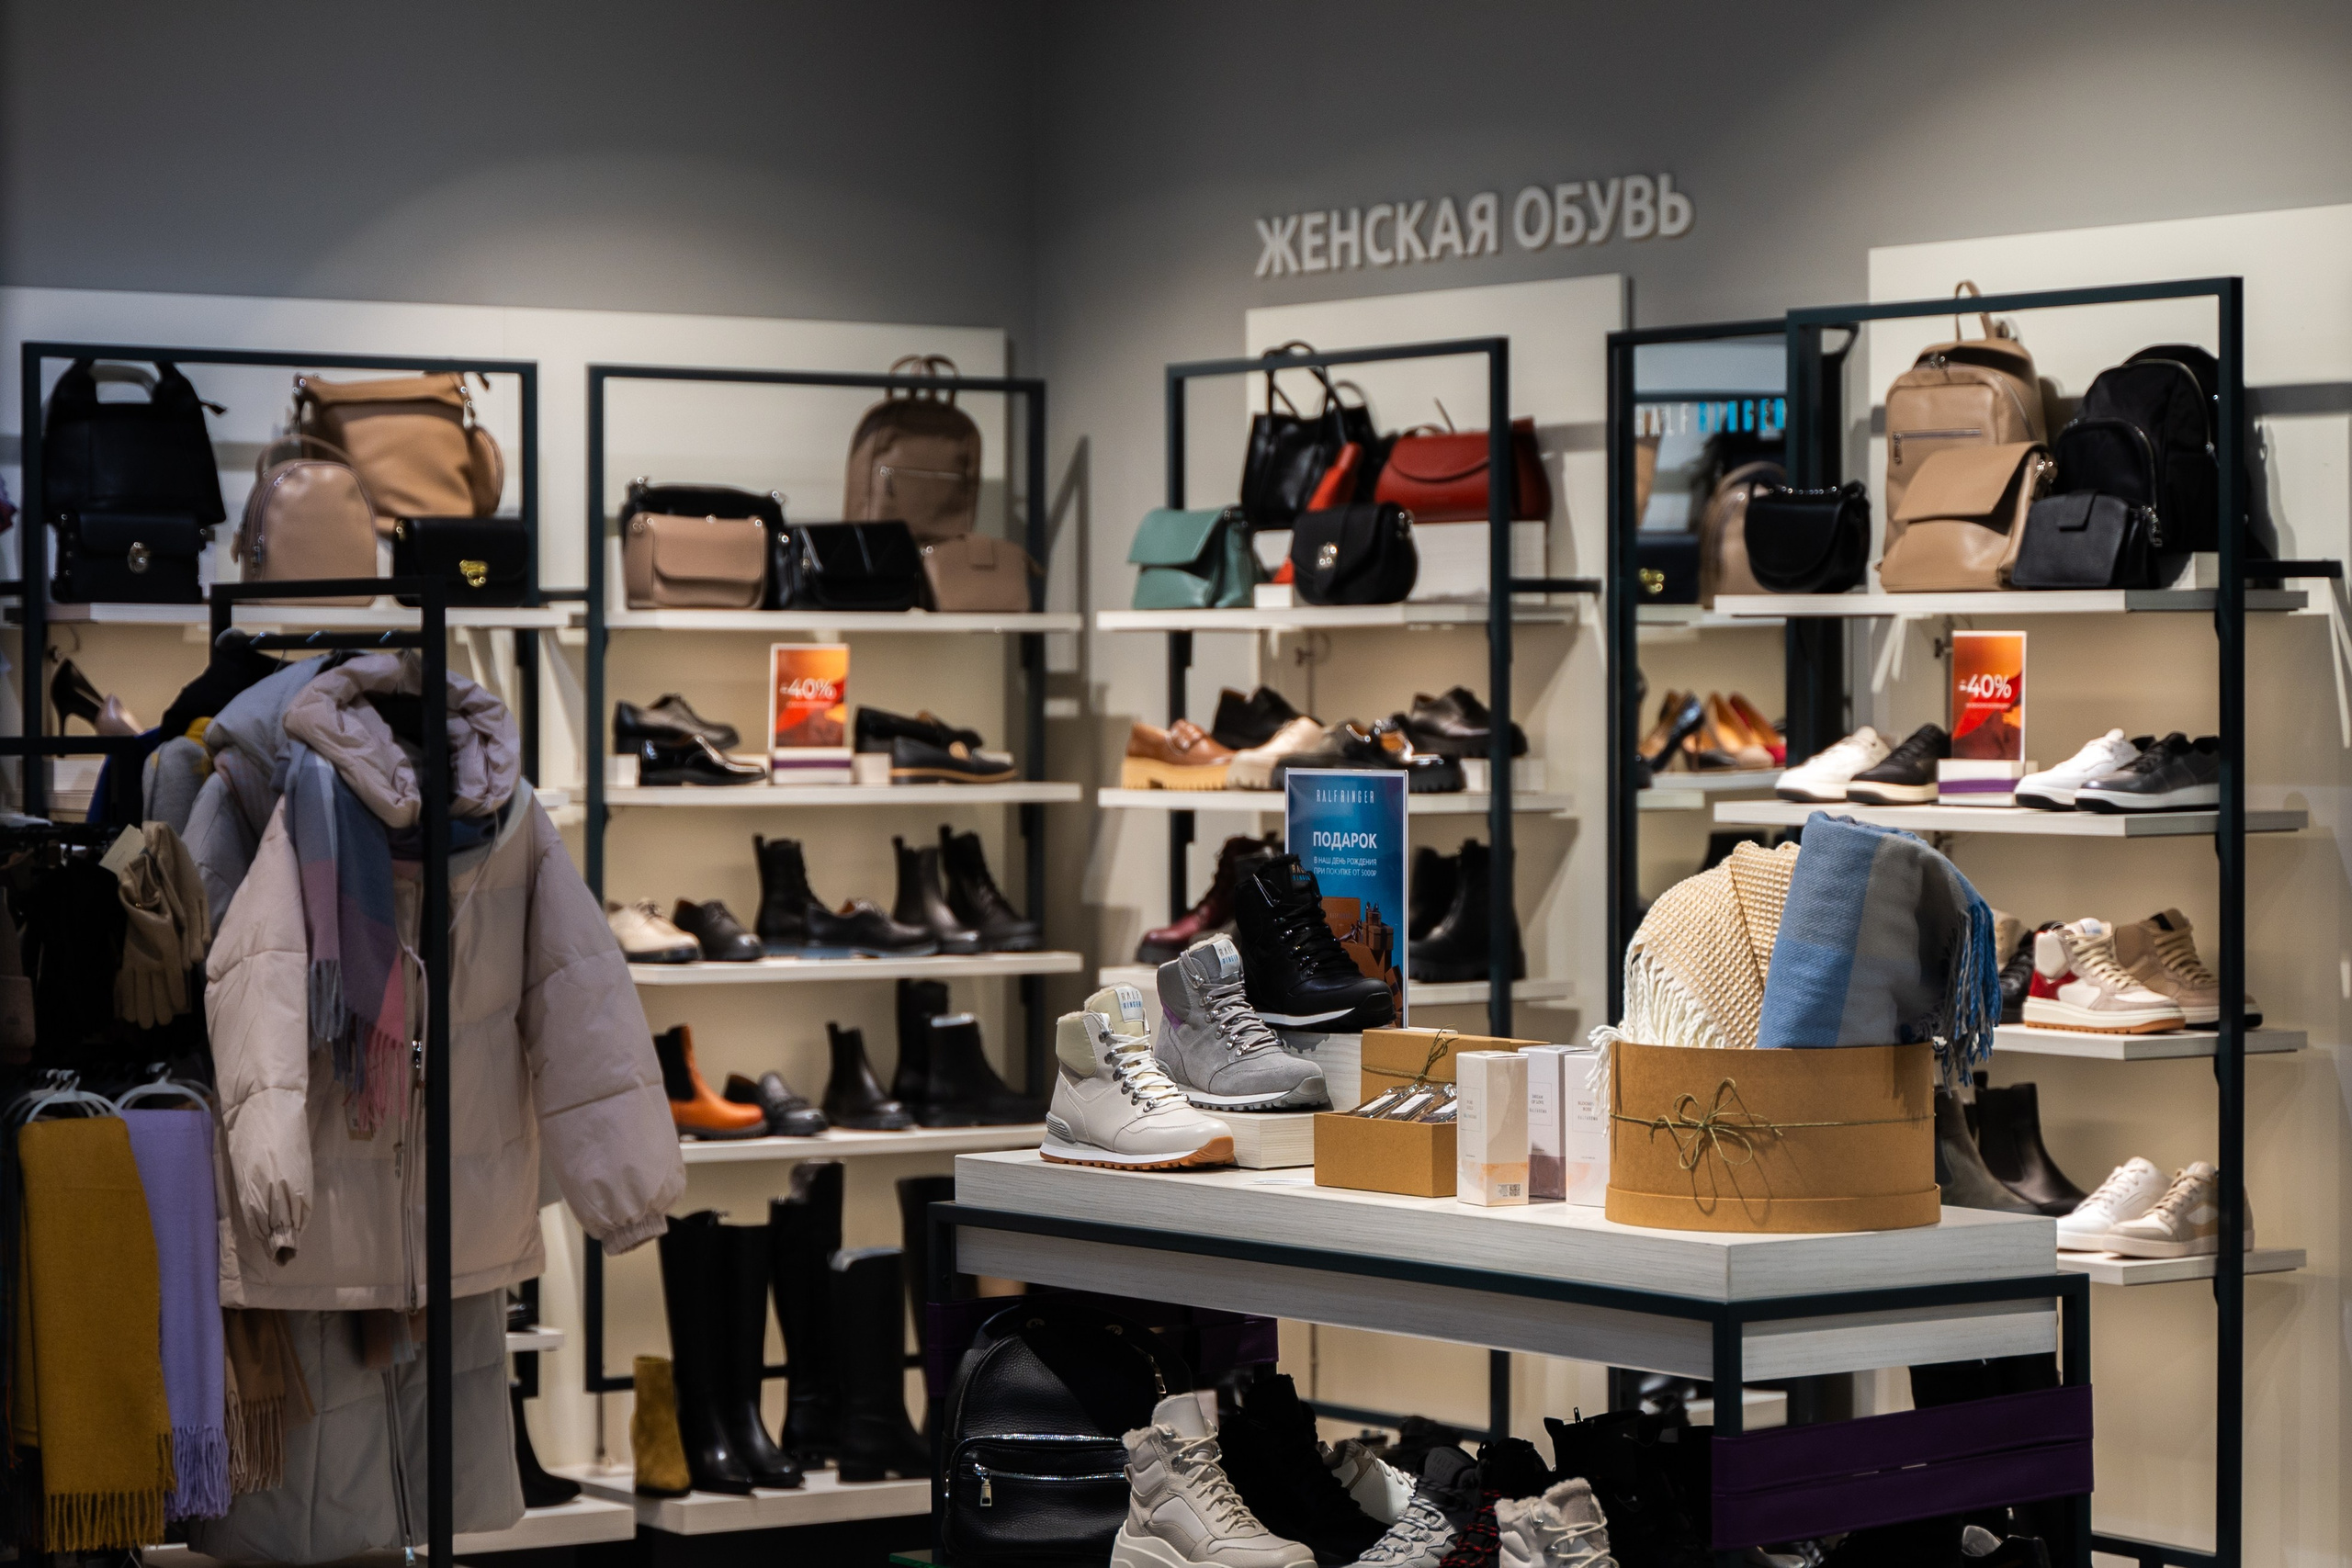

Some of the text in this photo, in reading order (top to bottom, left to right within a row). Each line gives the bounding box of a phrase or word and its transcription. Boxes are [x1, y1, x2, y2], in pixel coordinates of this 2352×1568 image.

[1254, 173, 1694, 277] ЖЕНСКАЯ ОБУВЬ
[780, 677, 838, 701] -40%
[1958, 673, 2012, 699] -40%
[1313, 831, 1377, 852] ПОДАРОК
[1326, 867, 1351, 876] ПОКУПКЕ
[1352, 868, 1360, 876] ОТ
[1331, 857, 1346, 865] ДЕНЬ
[1346, 857, 1377, 867] РОЖДЕНИЯ
[1121, 991, 1139, 1001] RALF
